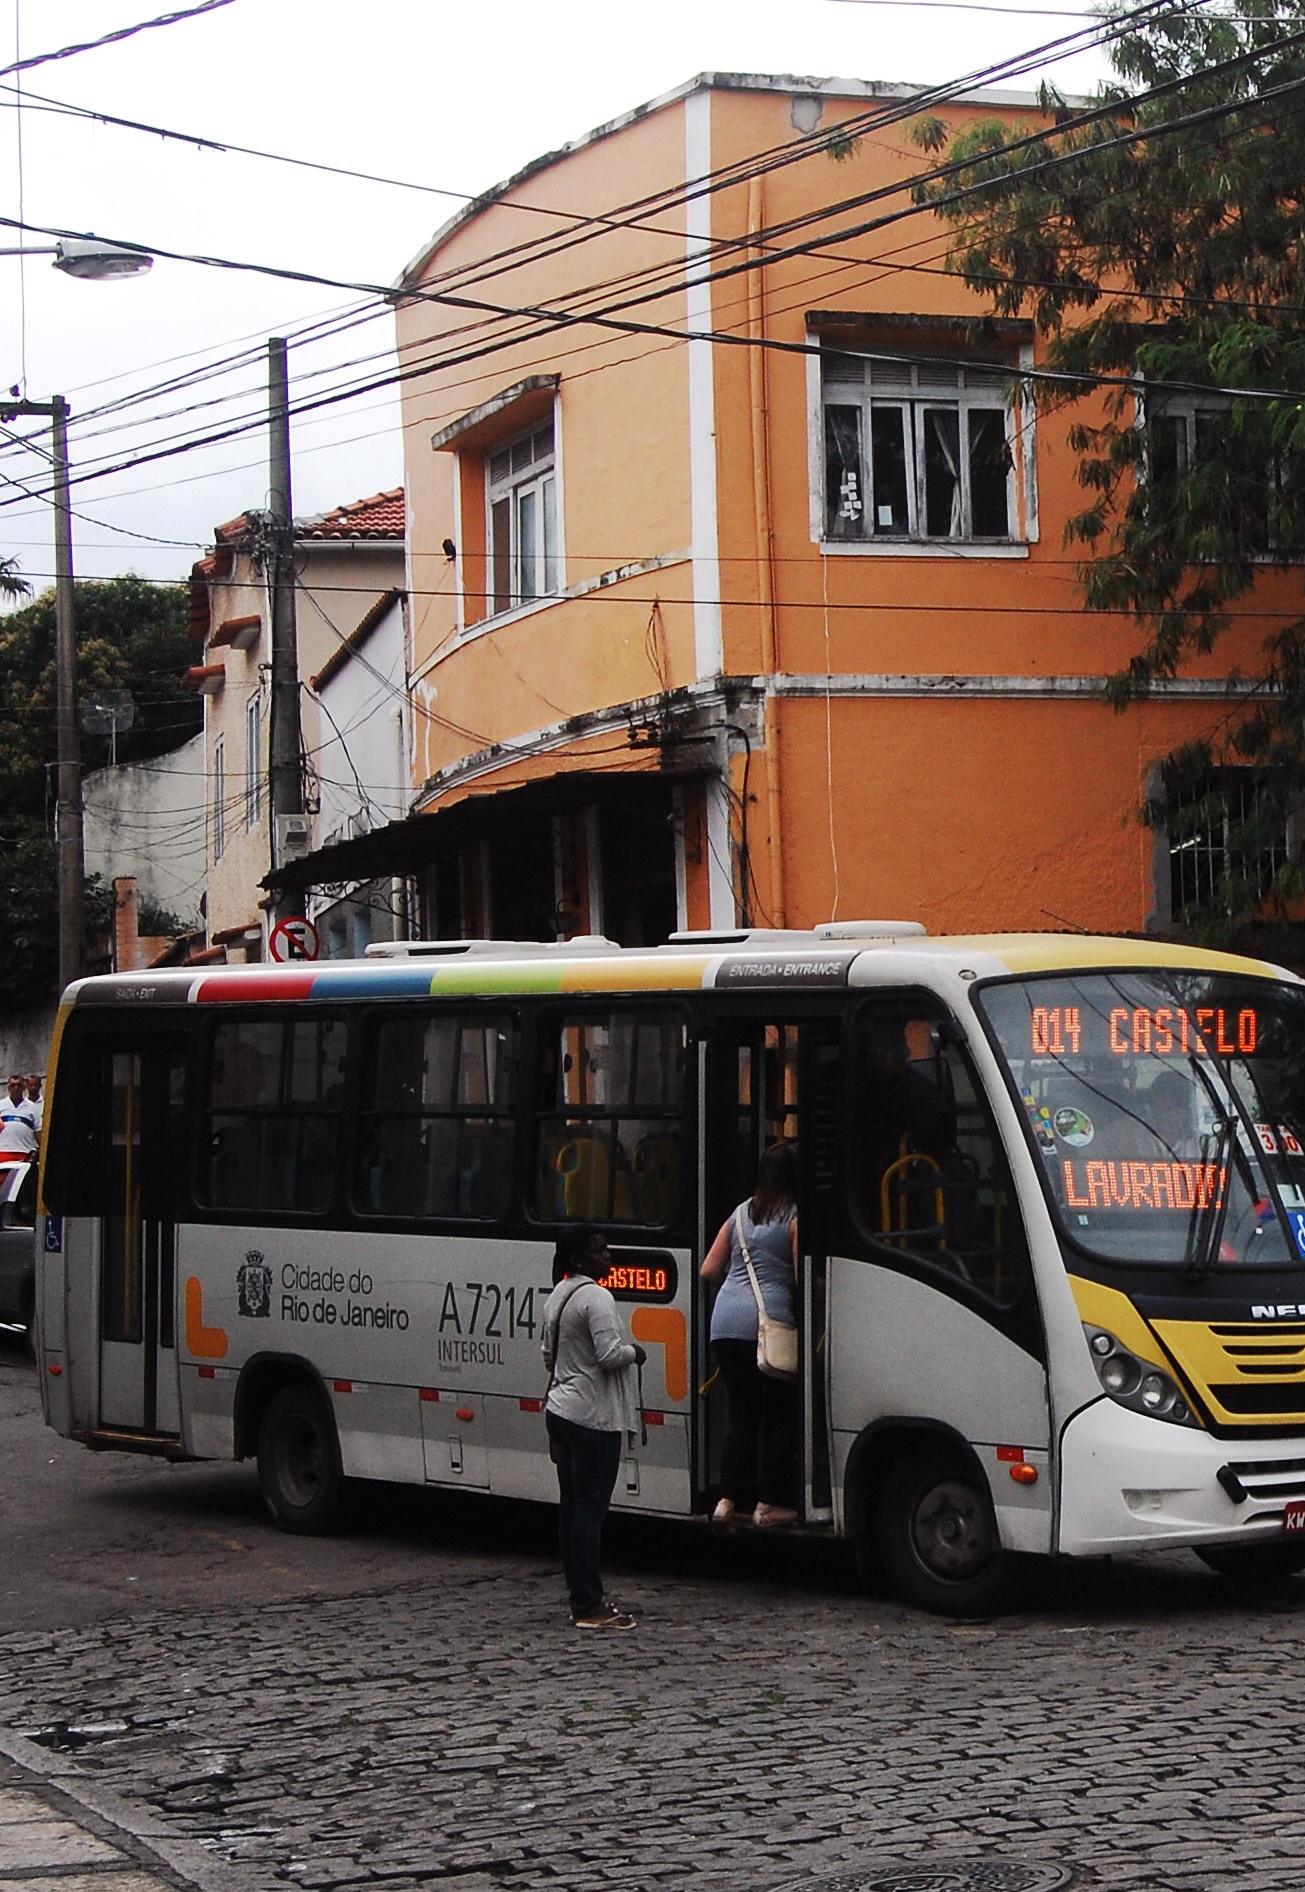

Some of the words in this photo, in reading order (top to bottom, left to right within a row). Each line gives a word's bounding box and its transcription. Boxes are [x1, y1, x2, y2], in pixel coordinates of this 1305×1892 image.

[729, 964, 777, 977] ENTRADA
[783, 961, 842, 976] ENTRANCE
[1031, 1007, 1081, 1053] 014
[1109, 1007, 1257, 1054] CASTELO
[281, 1263, 345, 1293] Cidade
[349, 1268, 373, 1295] do
[281, 1294, 310, 1323] Rio
[312, 1297, 338, 1325] de
[340, 1299, 410, 1331] Janeiro
[437, 1339, 504, 1366] INTERSUL
